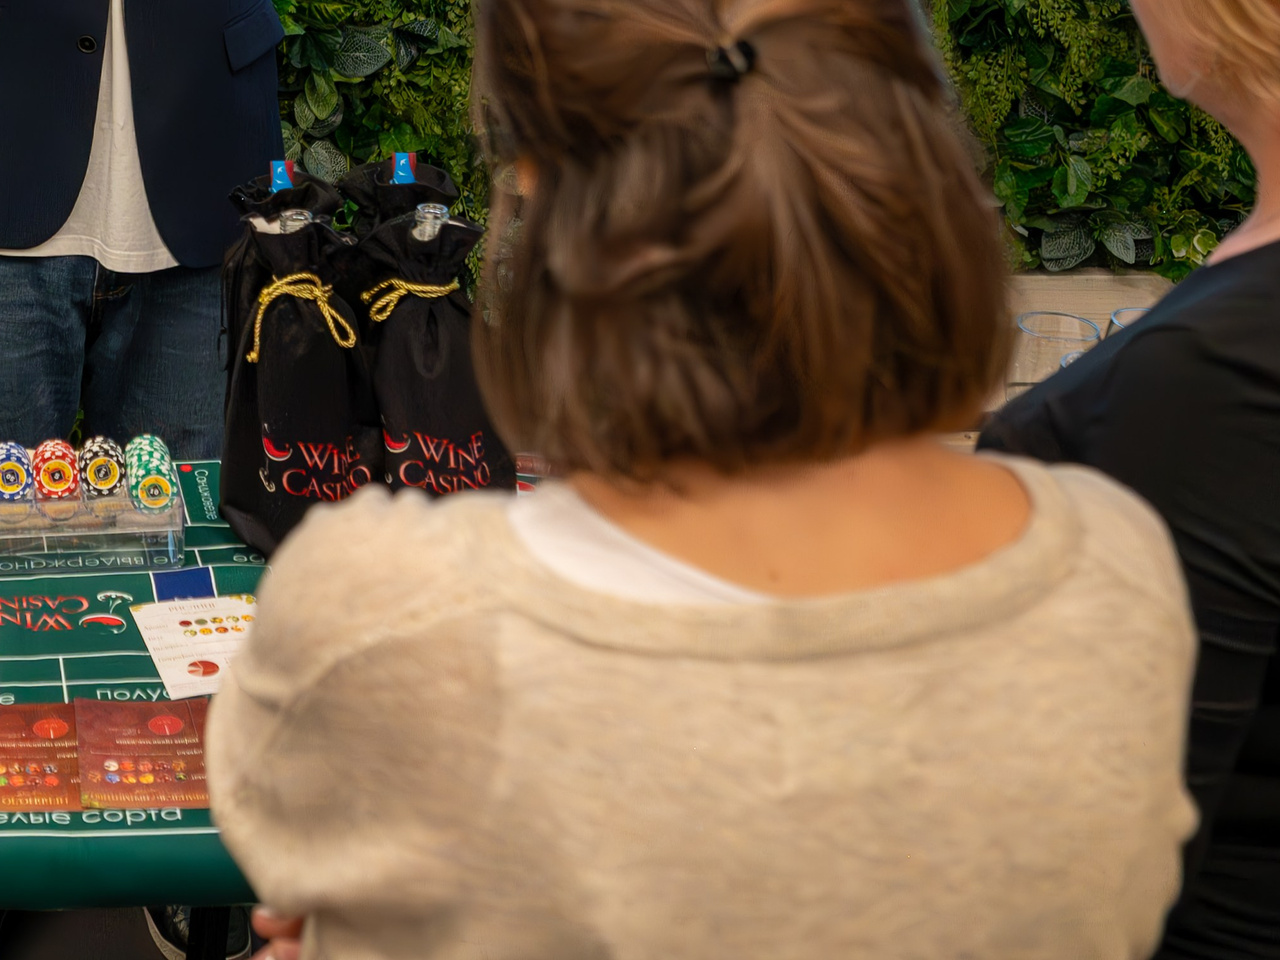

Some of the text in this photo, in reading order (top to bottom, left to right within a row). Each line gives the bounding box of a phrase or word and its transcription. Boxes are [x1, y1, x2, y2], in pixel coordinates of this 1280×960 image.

[297, 435, 361, 476] WINE
[413, 430, 483, 471] WINE
[399, 460, 491, 495] CASINO
[81, 807, 183, 826] сорта
